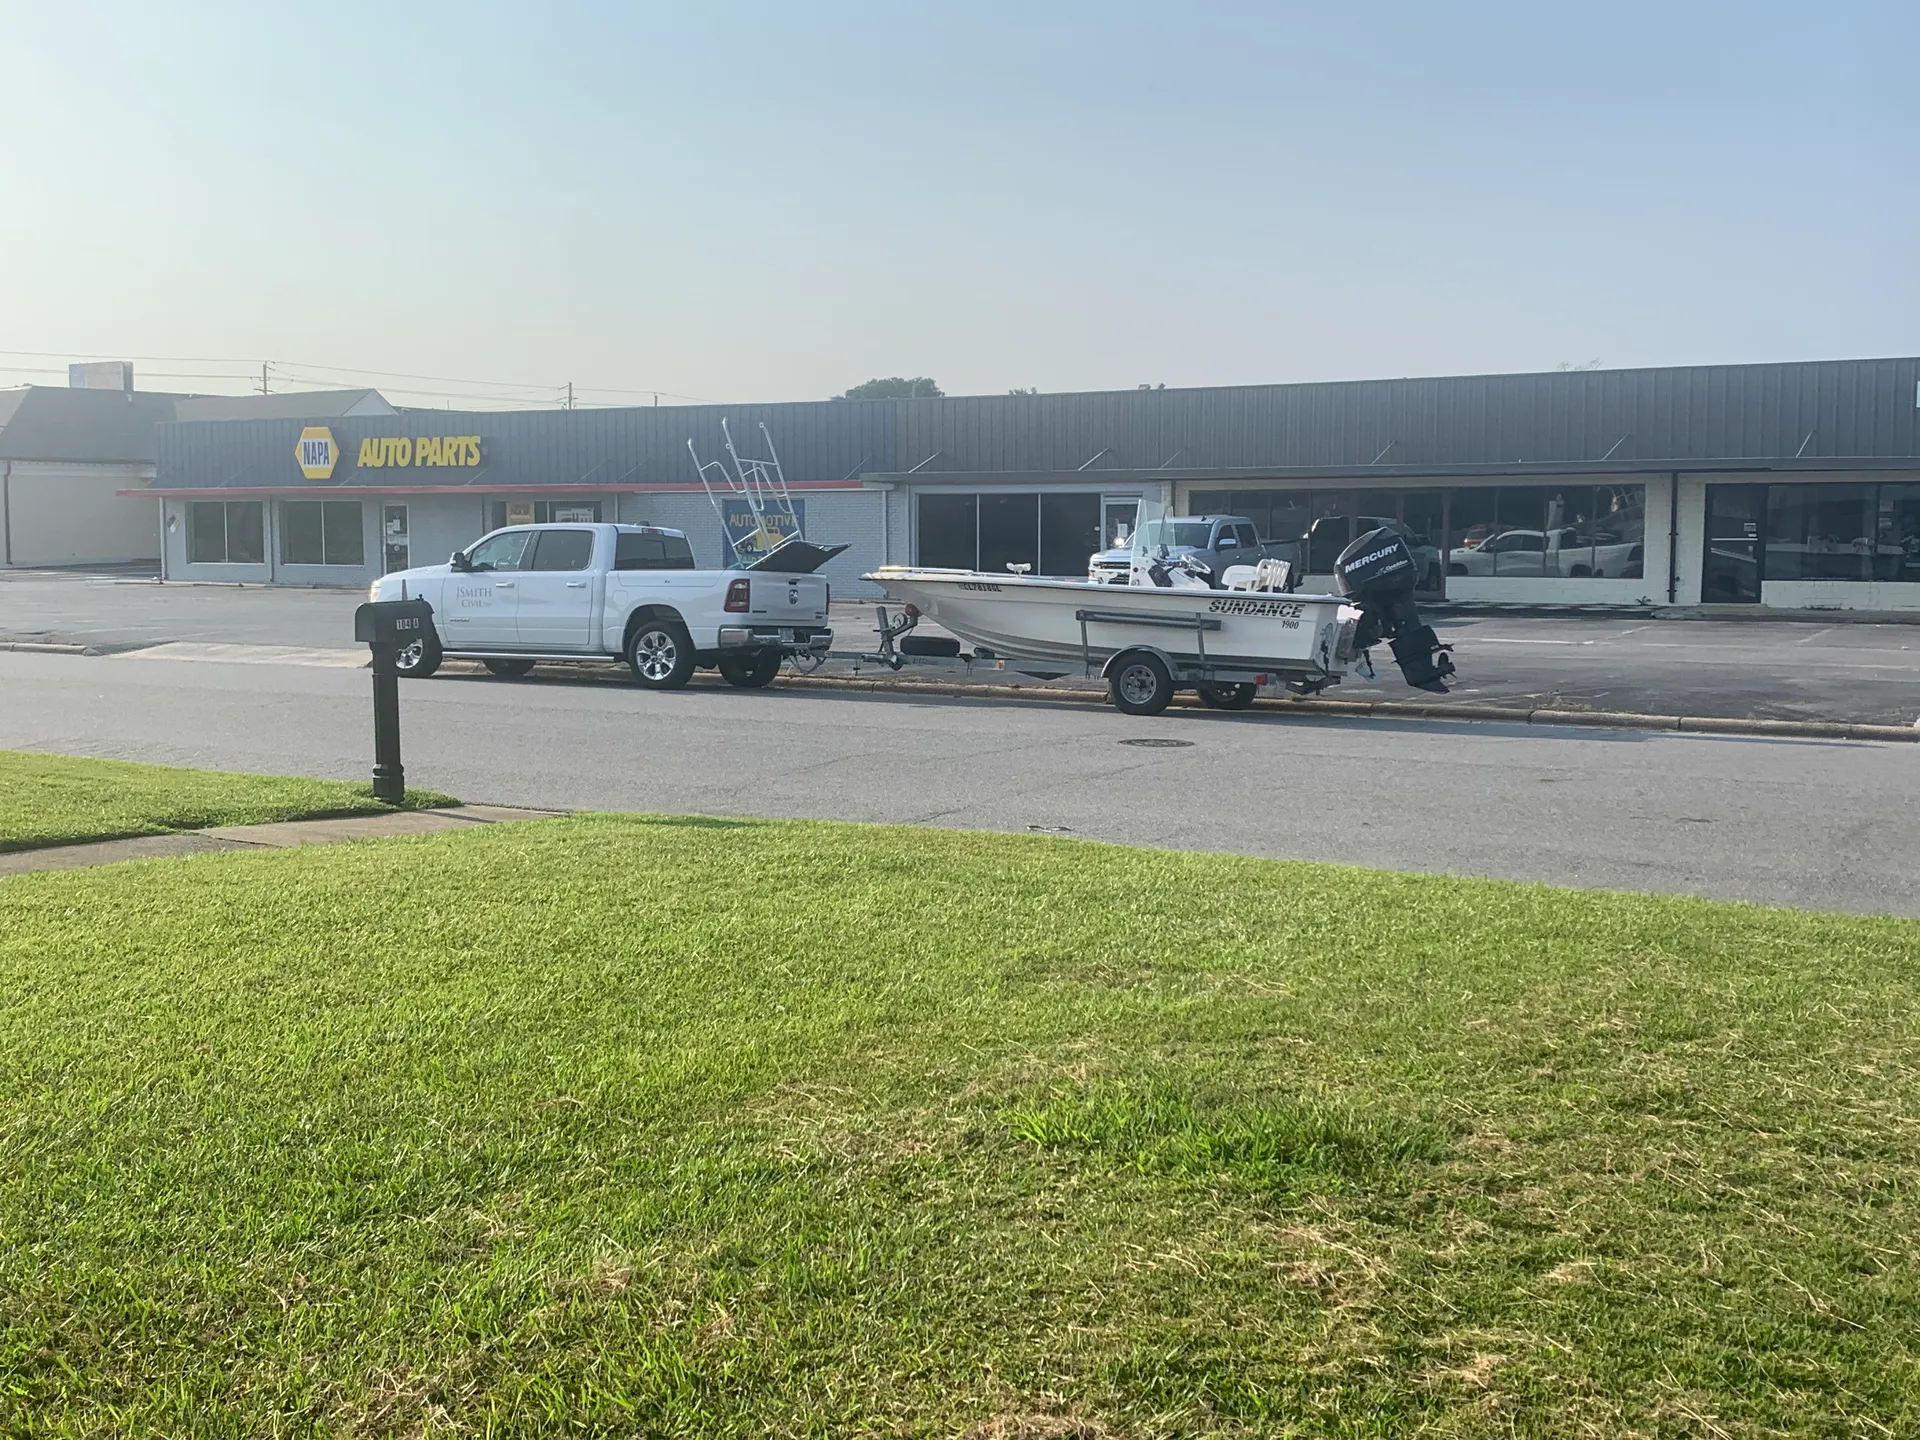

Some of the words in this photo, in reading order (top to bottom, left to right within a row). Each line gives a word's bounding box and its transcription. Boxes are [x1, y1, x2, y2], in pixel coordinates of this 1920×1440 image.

[303, 441, 330, 465] NAPA
[357, 437, 412, 467] AUTO
[415, 436, 481, 466] PARTS
[729, 514, 800, 527] AUTOOTIVE
[1345, 543, 1399, 573] MERCURY
[1209, 600, 1306, 618] SUNDANCE
[1281, 621, 1300, 629] 1900
